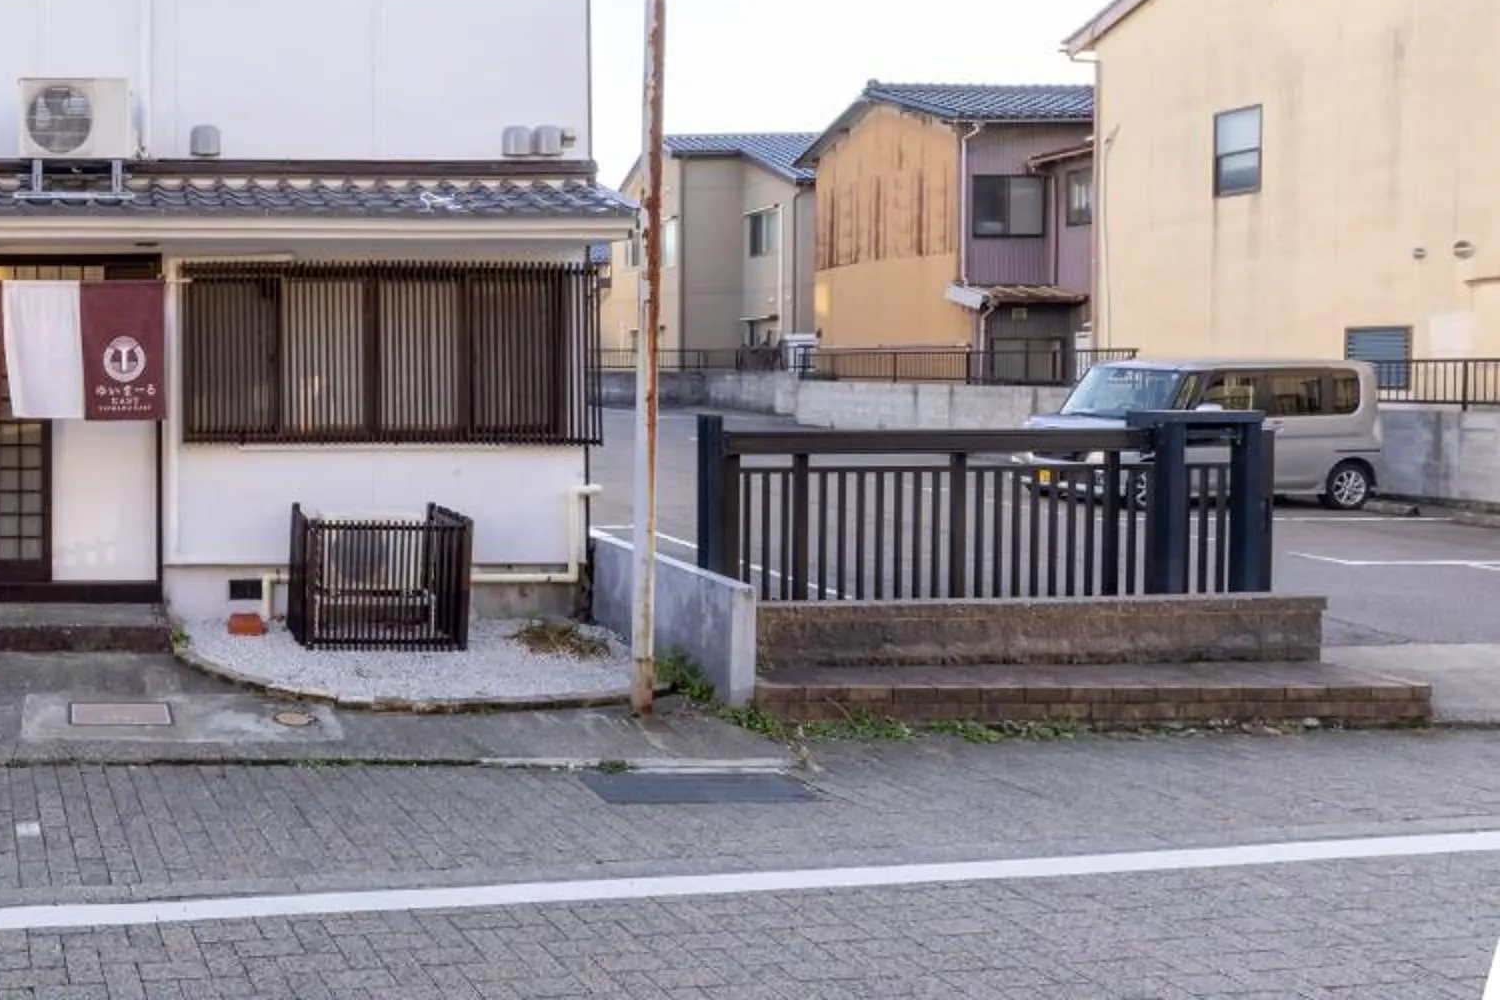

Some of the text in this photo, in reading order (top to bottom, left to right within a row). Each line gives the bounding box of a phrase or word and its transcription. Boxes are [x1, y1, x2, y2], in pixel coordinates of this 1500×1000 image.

[95, 383, 157, 397] ゆいまーる
